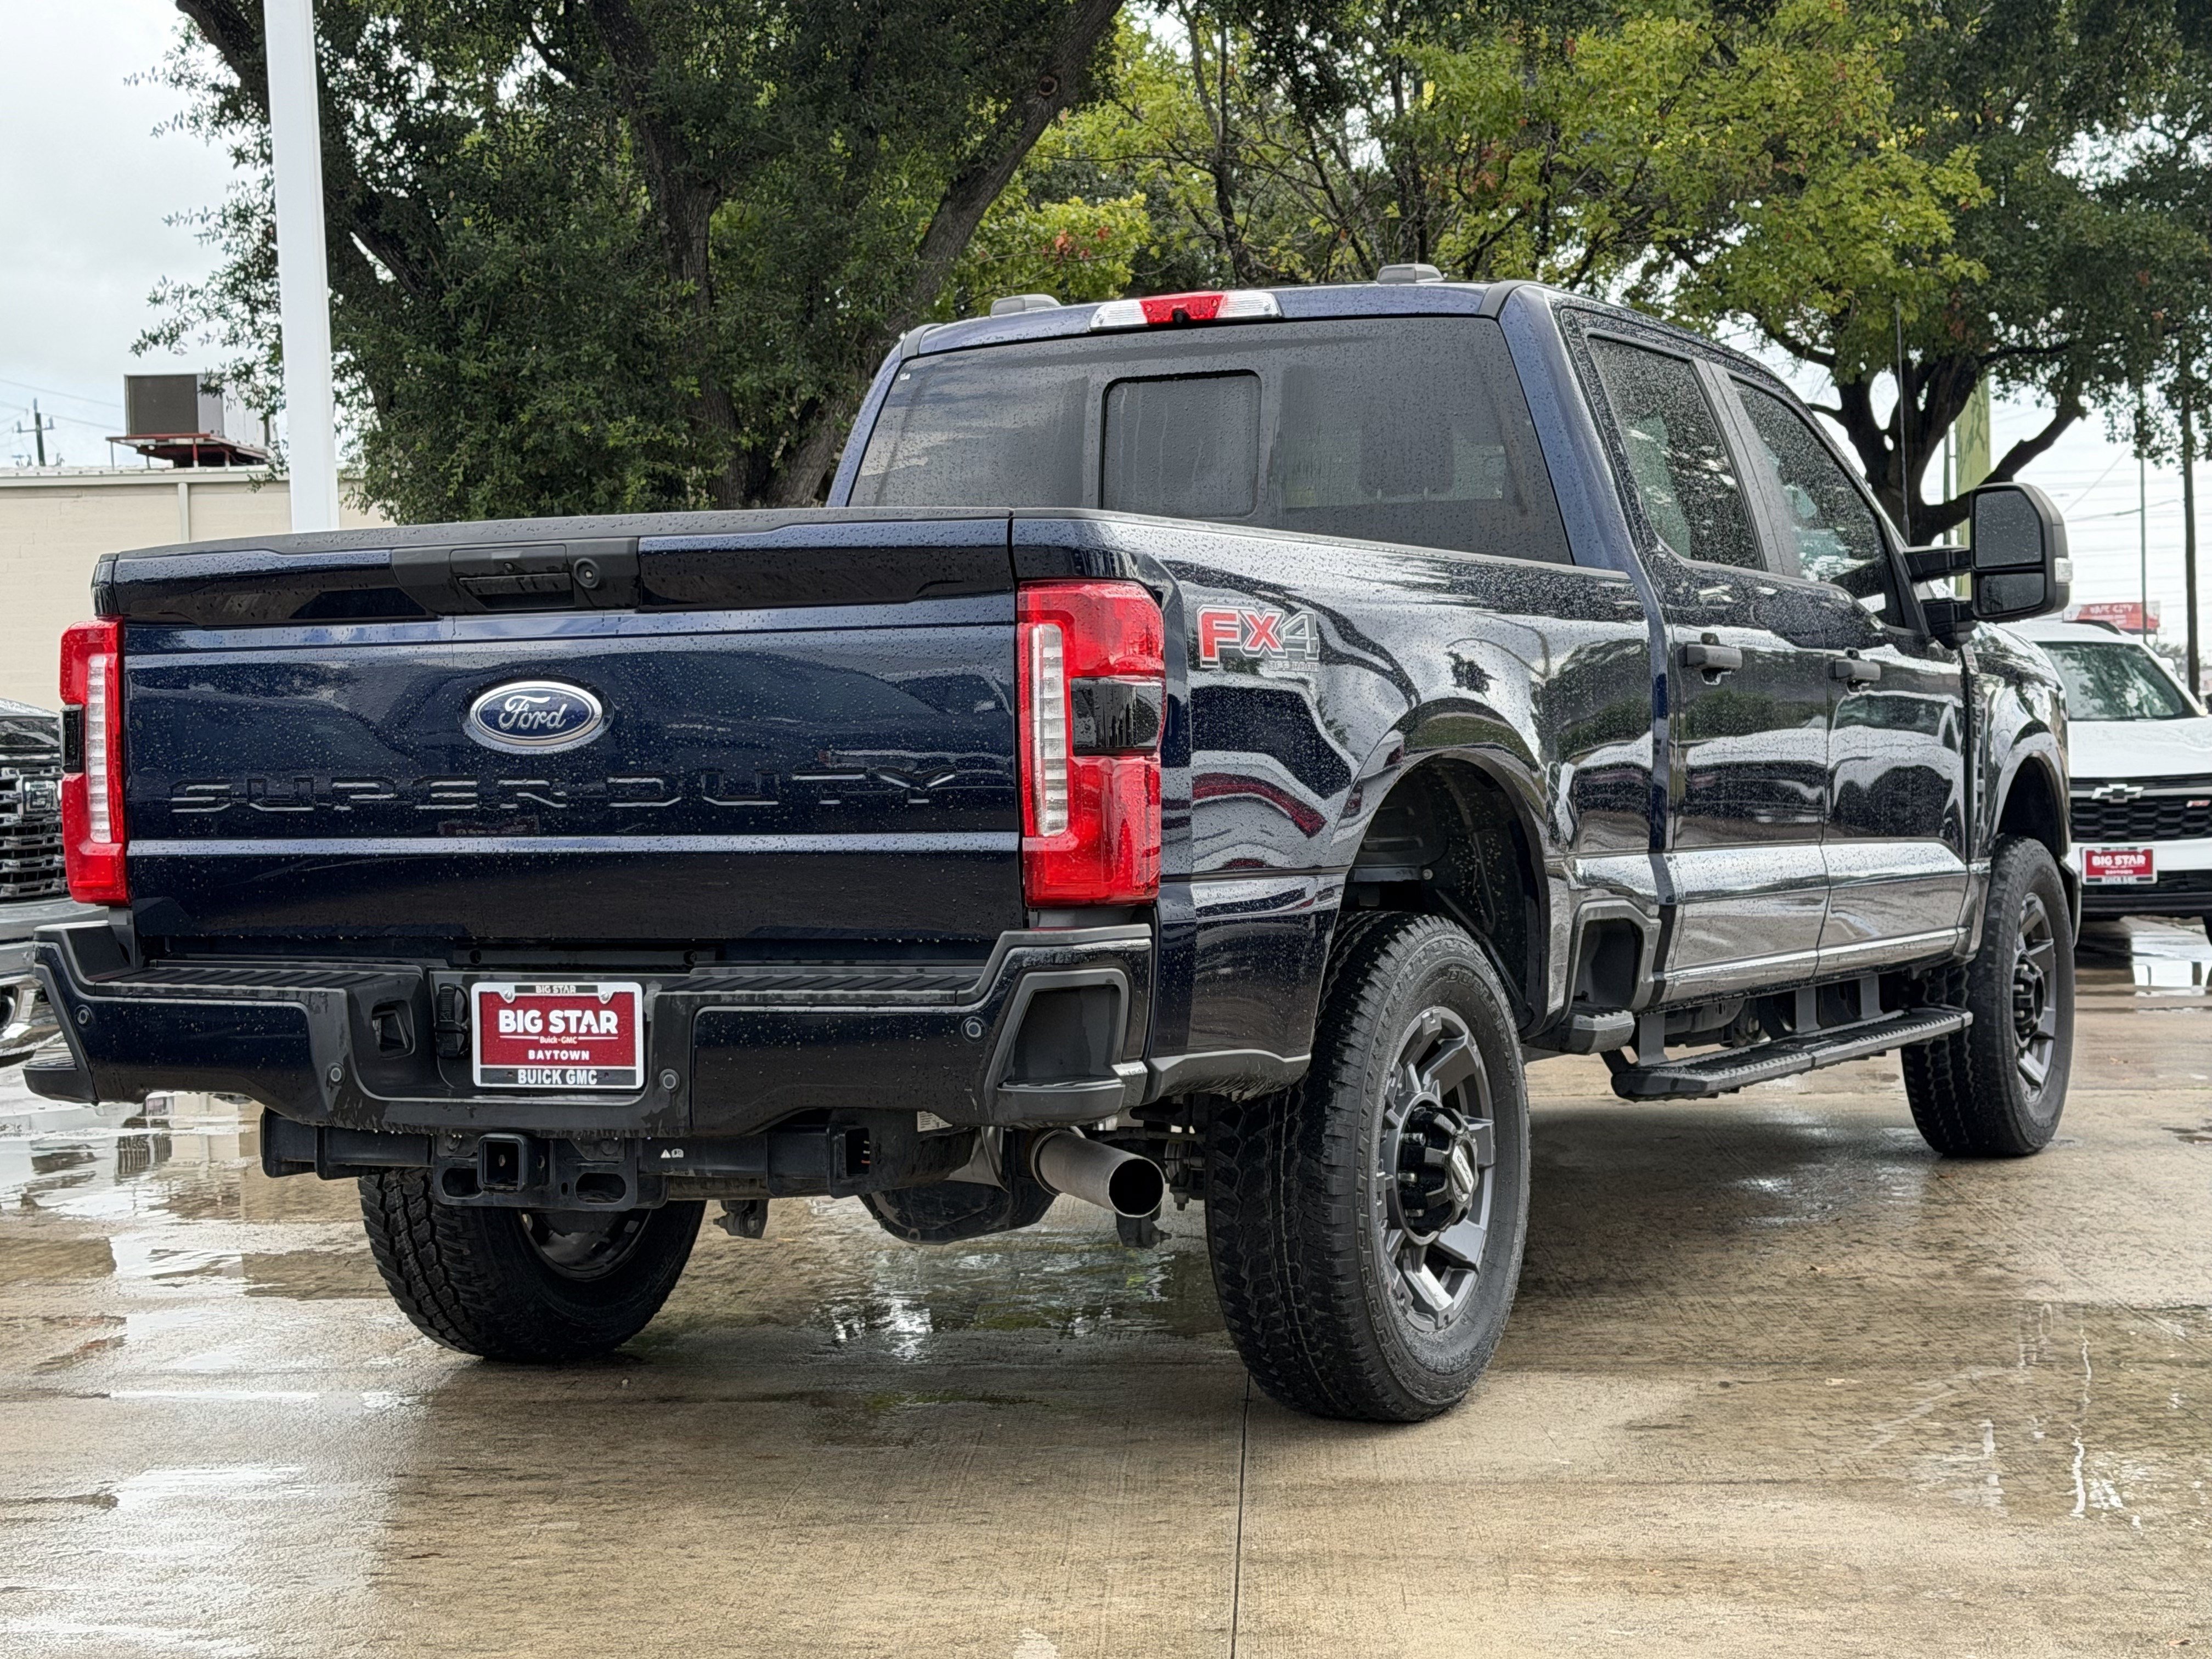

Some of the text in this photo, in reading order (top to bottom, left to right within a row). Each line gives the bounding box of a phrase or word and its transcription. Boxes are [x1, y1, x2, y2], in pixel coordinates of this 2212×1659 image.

[1197, 604, 1320, 668] FX4
[498, 695, 567, 731] Ford
[170, 768, 956, 814] SUPER DUTY
[2092, 855, 2146, 866] BIG STAR
[535, 985, 576, 994] BIG STAR
[499, 1009, 618, 1034] BIG STAR
[528, 1049, 589, 1060] BAYTOWN
[518, 1069, 597, 1085] BUICK GMC
